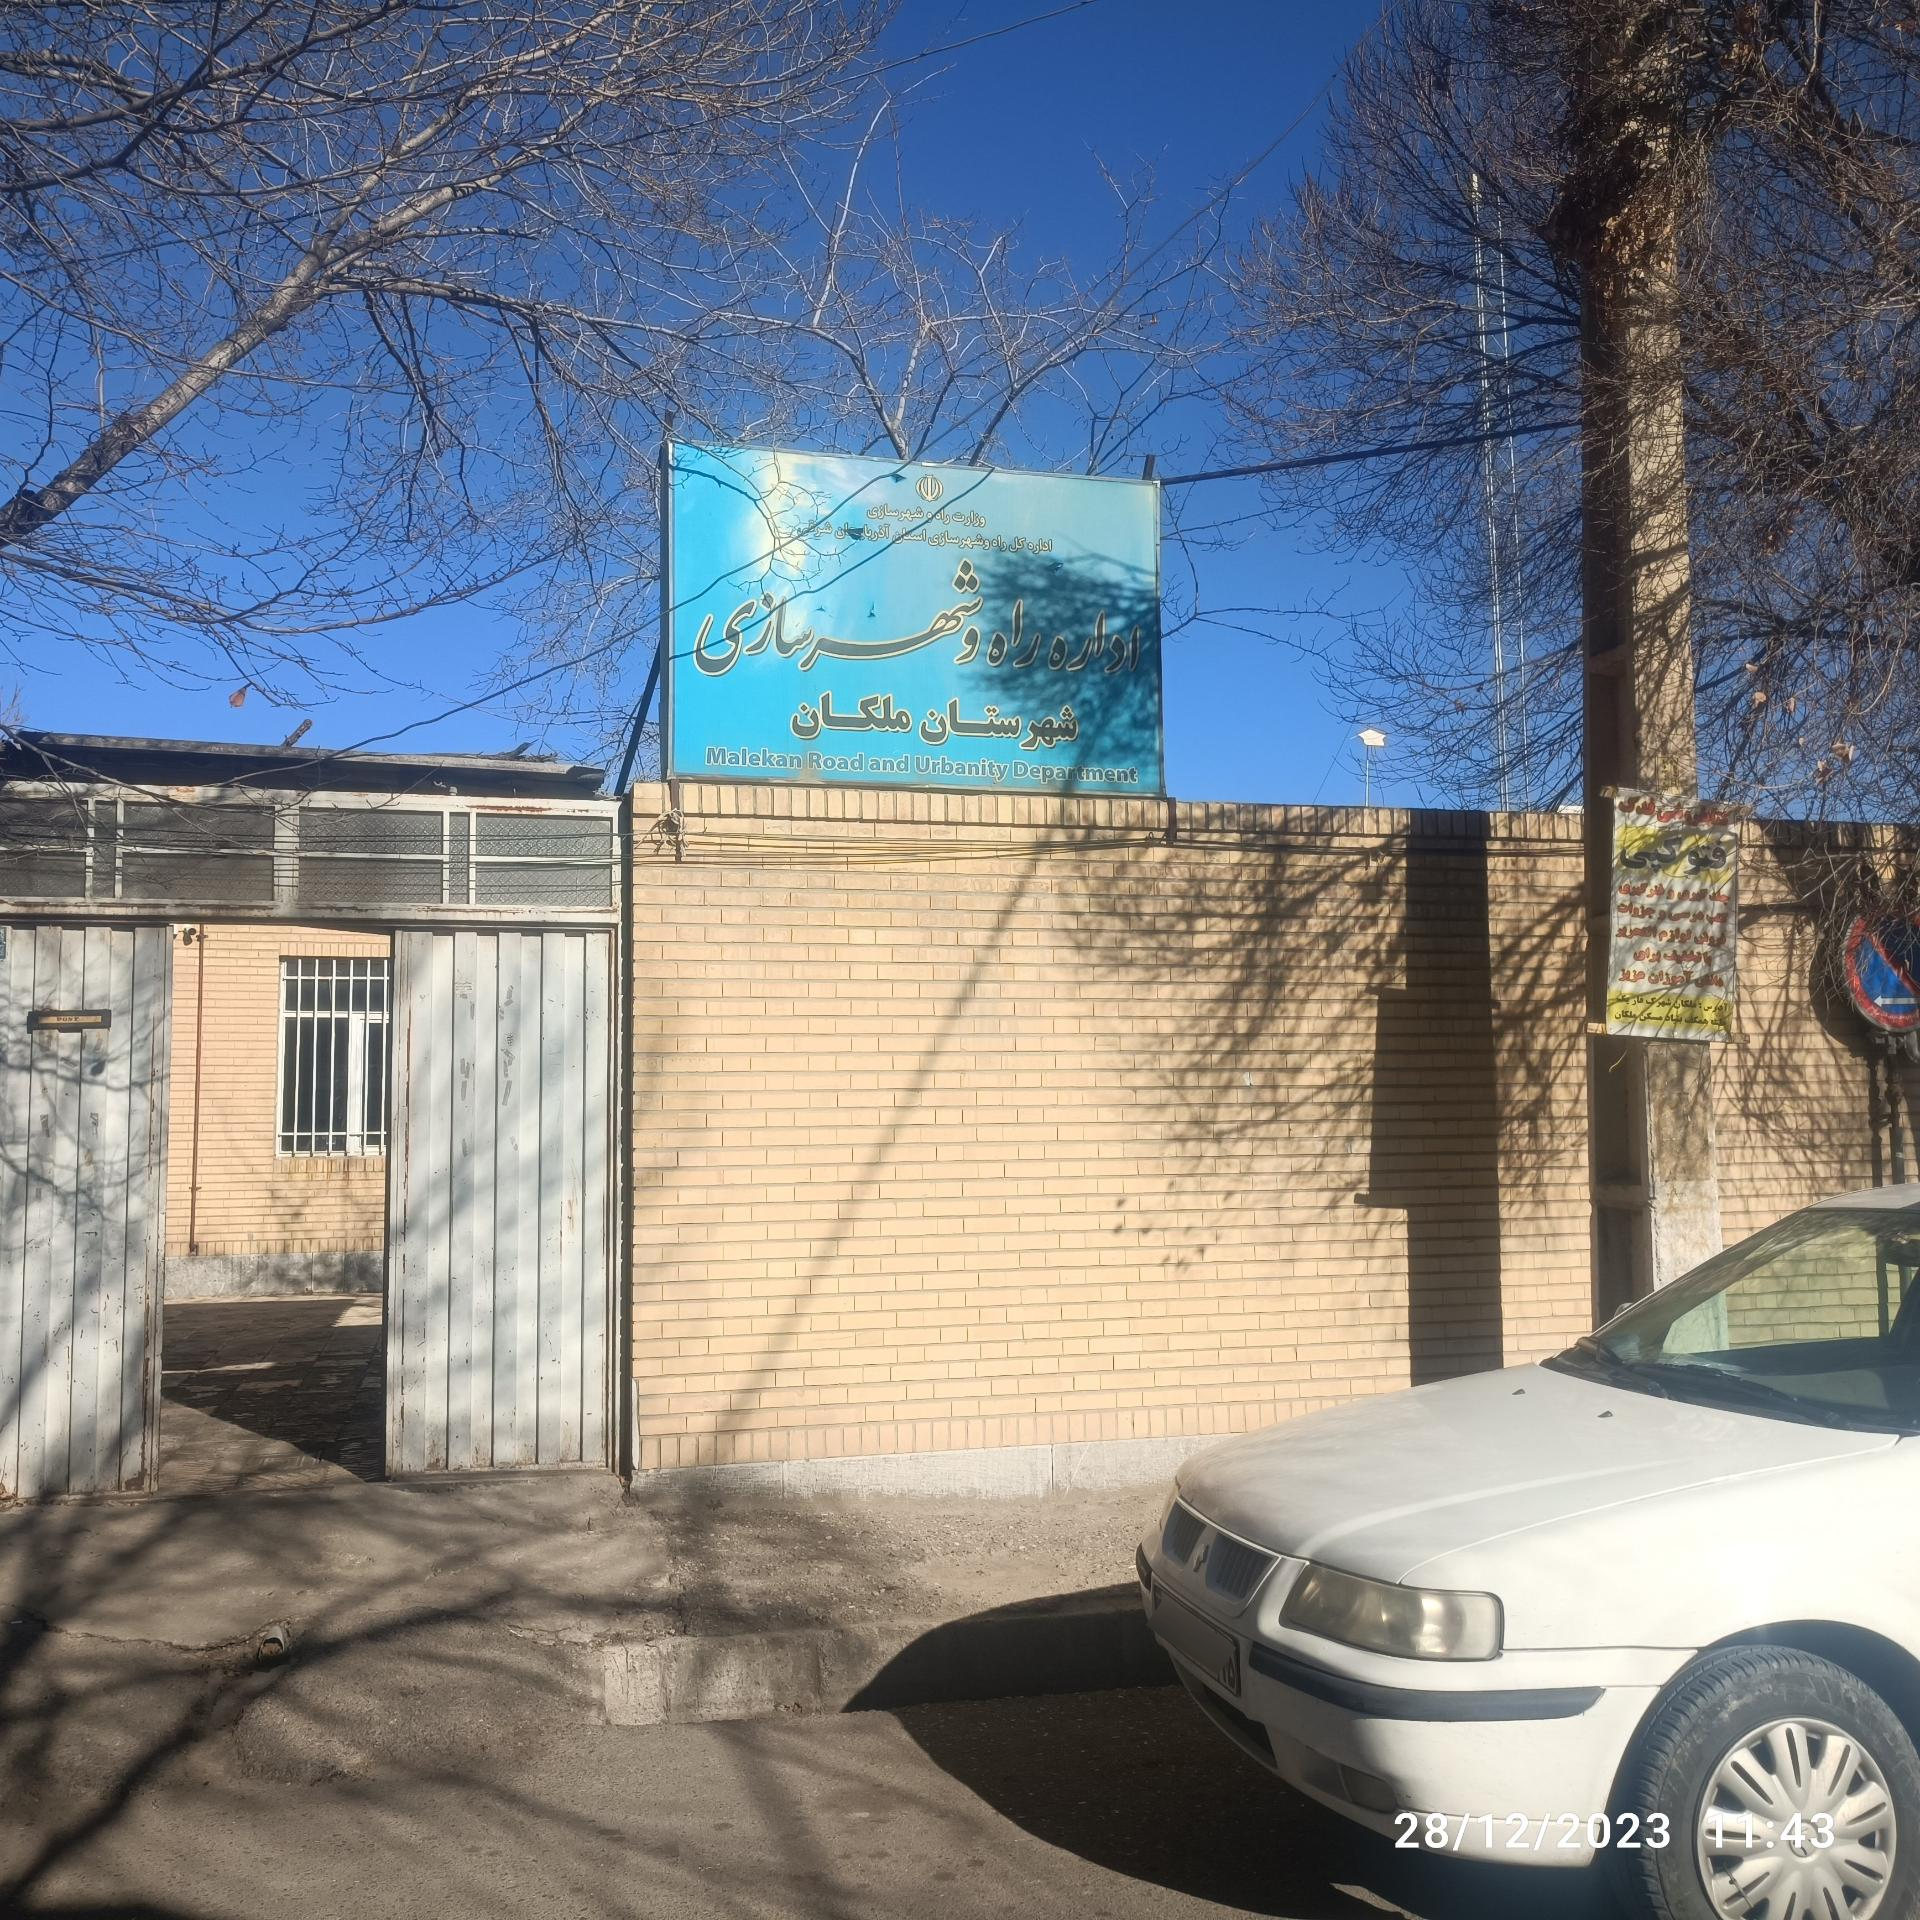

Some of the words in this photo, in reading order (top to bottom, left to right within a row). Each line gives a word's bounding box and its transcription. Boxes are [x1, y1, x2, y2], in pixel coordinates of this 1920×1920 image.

[866, 504, 925, 521] شهرسازی
[935, 506, 950, 524] راه
[952, 510, 987, 528] وزارت
[834, 522, 890, 541] آذرباان
[991, 535, 1007, 552] راه
[1009, 536, 1026, 552] کل
[1027, 538, 1053, 555] اداره
[693, 557, 984, 677] شهرسازی
[985, 598, 1042, 668] راه
[1047, 609, 1140, 674] اداره
[790, 691, 912, 739] ملکان
[919, 698, 1080, 751] شهرستان
[705, 746, 802, 769] Malekan
[807, 751, 865, 772] Road
[868, 753, 910, 774] and
[914, 755, 1010, 784] Urbanity
[1012, 761, 1139, 787] Department
